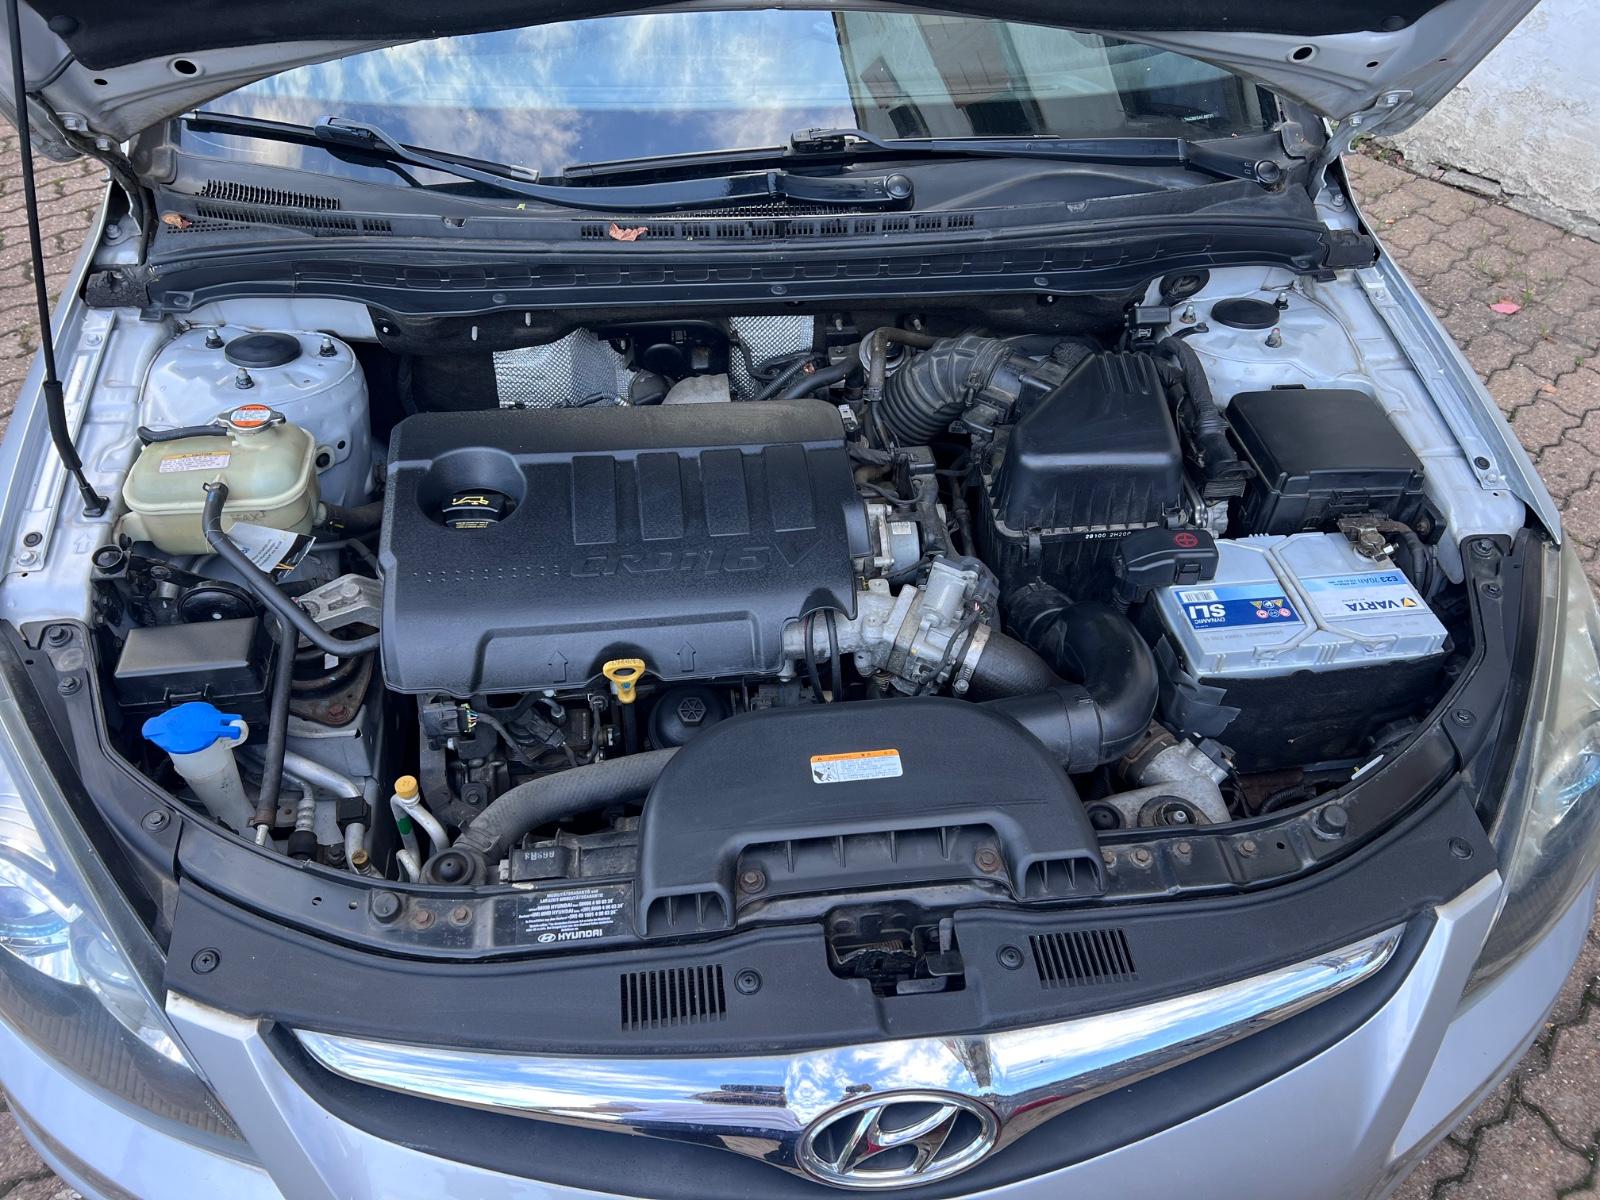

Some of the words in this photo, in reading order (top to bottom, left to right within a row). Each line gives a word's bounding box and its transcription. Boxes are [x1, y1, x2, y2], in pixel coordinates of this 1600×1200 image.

[1380, 575, 1398, 583] E23
[1188, 603, 1226, 619] SLI
[1345, 600, 1400, 612] VARTA
[1194, 617, 1226, 625] DYNAMIC
[557, 929, 603, 941] HYUNDAI
